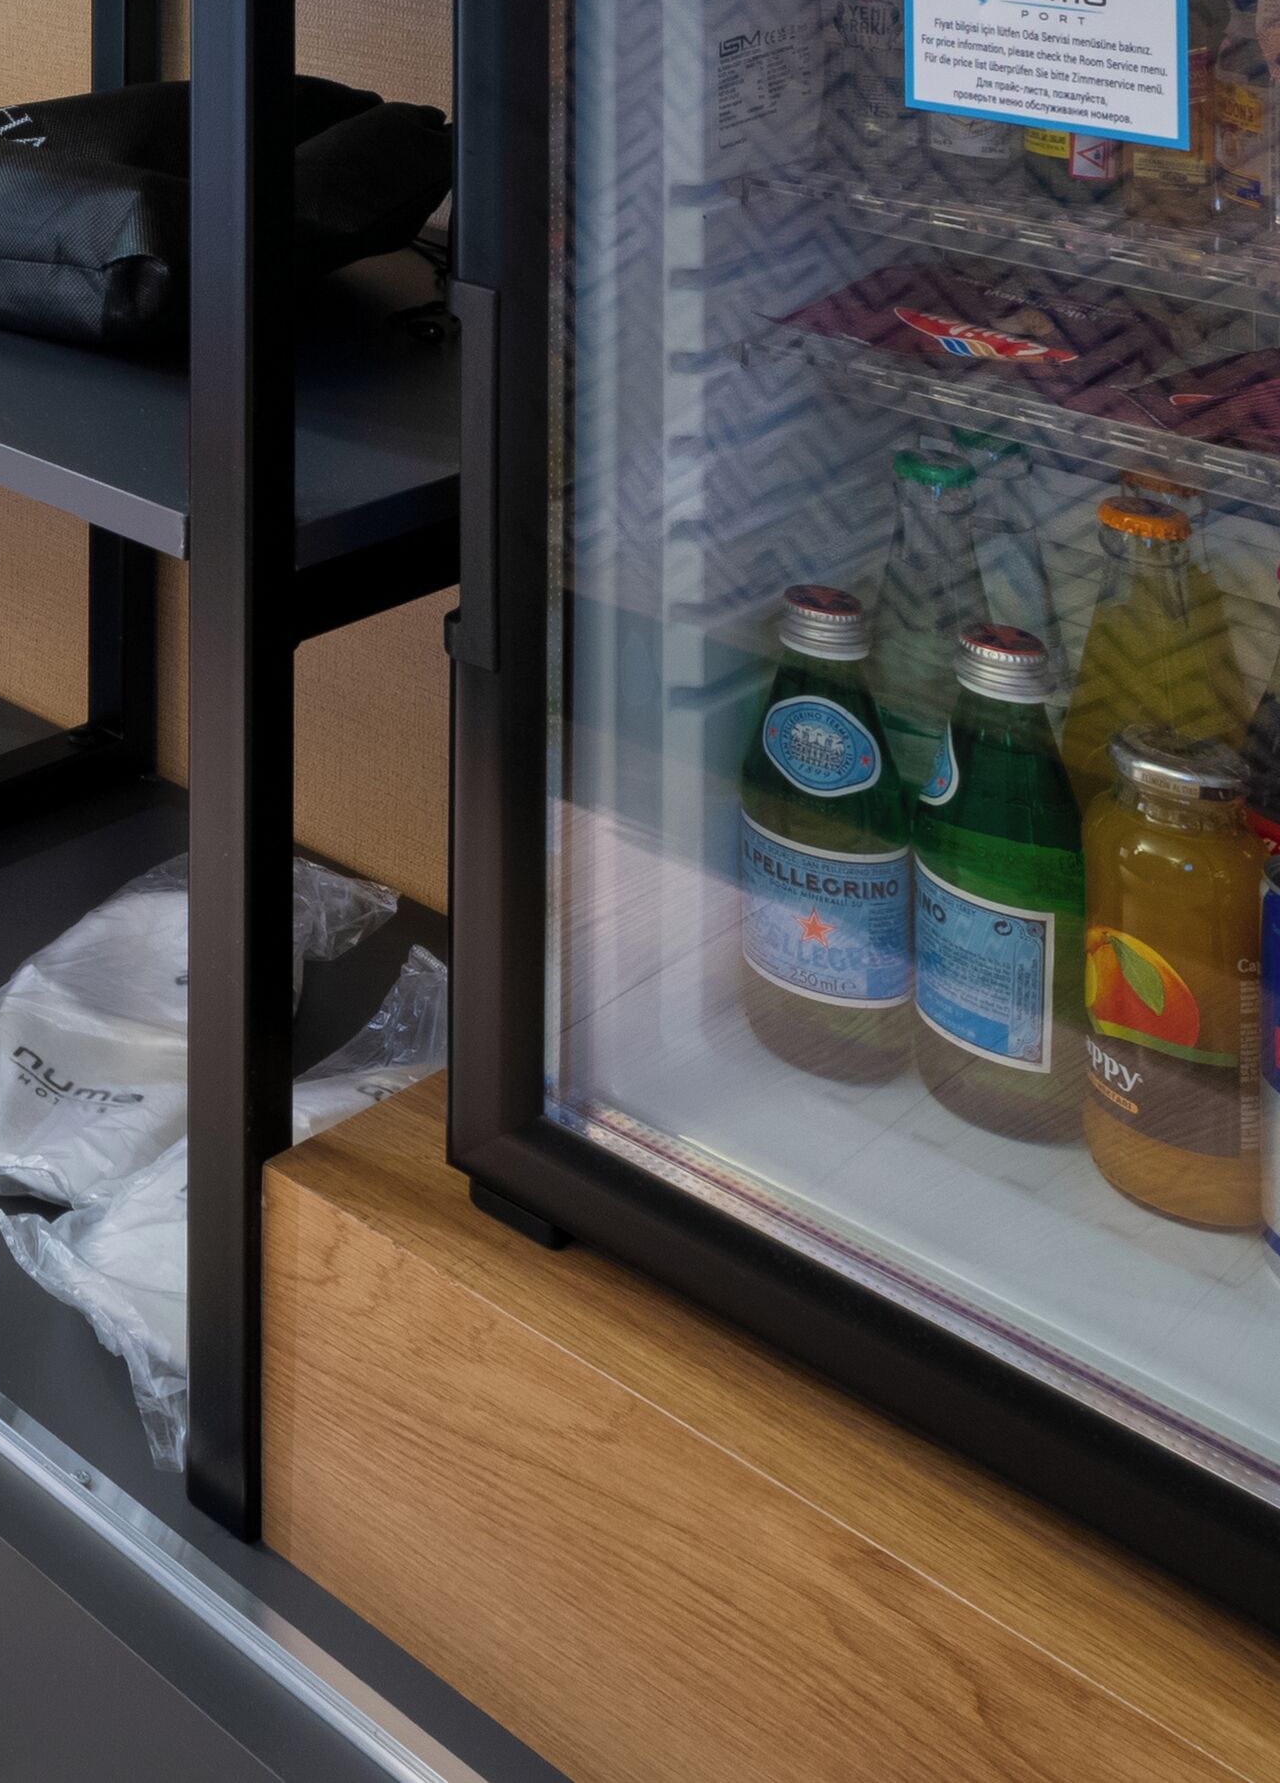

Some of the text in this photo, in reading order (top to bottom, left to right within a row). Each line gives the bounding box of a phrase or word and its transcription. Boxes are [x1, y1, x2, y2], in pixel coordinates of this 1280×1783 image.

[1021, 9, 1086, 25] PORT
[921, 34, 1169, 77] For price information, please check the Room Service menu.
[934, 17, 1153, 57] Fiyat bilgisi için lütfen Oda Servisi menüsüne bakınız.
[924, 51, 1166, 96] Für die price list überprüfen Sie bitte Zimmerservice menü.
[976, 76, 1109, 107] Для прайс-листа, пожалуйста,
[953, 90, 1134, 125] проверьте меню обслуживания номеров.
[789, 967, 839, 994] 250 ml
[13, 1045, 145, 1103] numa
